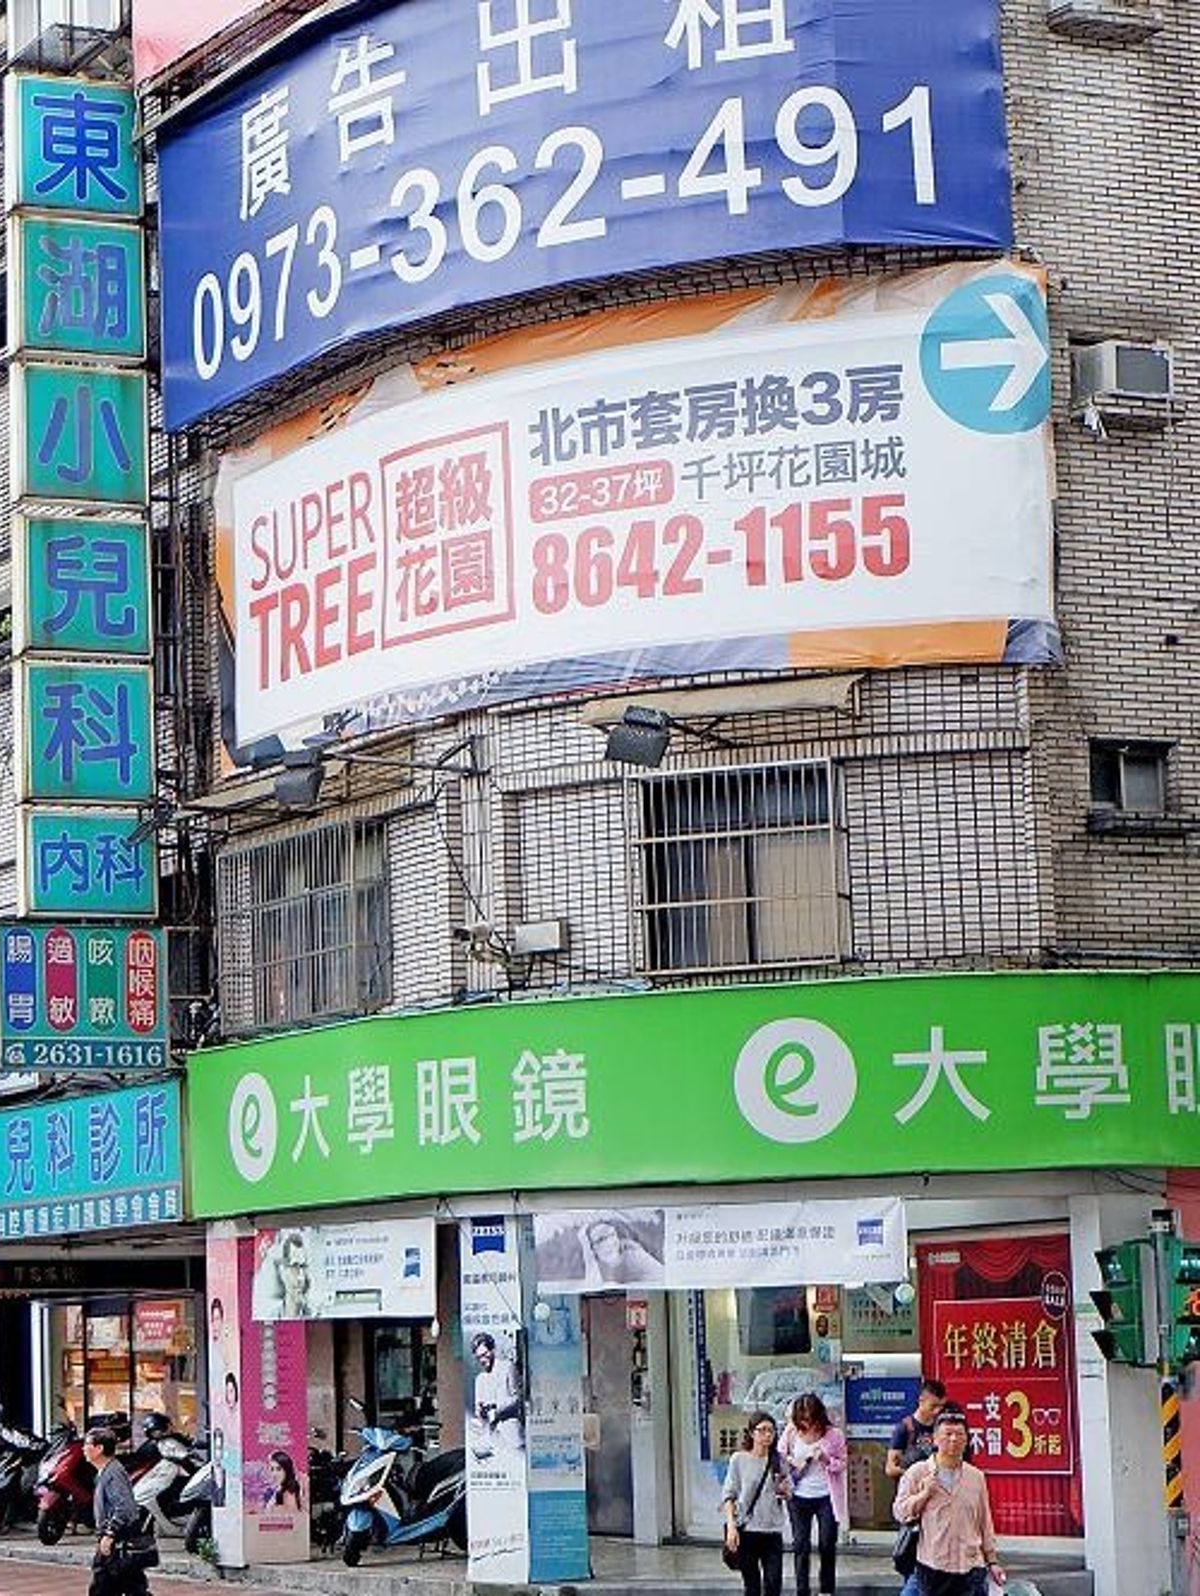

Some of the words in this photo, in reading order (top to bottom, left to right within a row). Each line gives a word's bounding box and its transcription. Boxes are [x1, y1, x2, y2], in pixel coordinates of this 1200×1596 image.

[237, 0, 796, 222] 廣告出租
[193, 85, 938, 381] 0973-362-491
[31, 92, 138, 786] 東湖小兒科
[528, 362, 904, 466] 北市套房換3房
[395, 448, 493, 541] 超級
[681, 436, 907, 502] 千坪花園城
[251, 469, 373, 591] SUPER
[531, 493, 910, 615] 8642-1155
[249, 556, 376, 691] TREE
[395, 533, 494, 625] 花園
[39, 831, 145, 894] 內科
[6, 935, 34, 1024] 腸胃
[47, 937, 75, 1024] 過敏
[88, 938, 114, 1024] 咳嗽
[128, 938, 155, 1026] 咽喉痛
[32, 1043, 162, 1066] 2631-1616
[288, 1047, 591, 1164] 大學眼鏡
[943, 1319, 1058, 1371] 年終清倉
